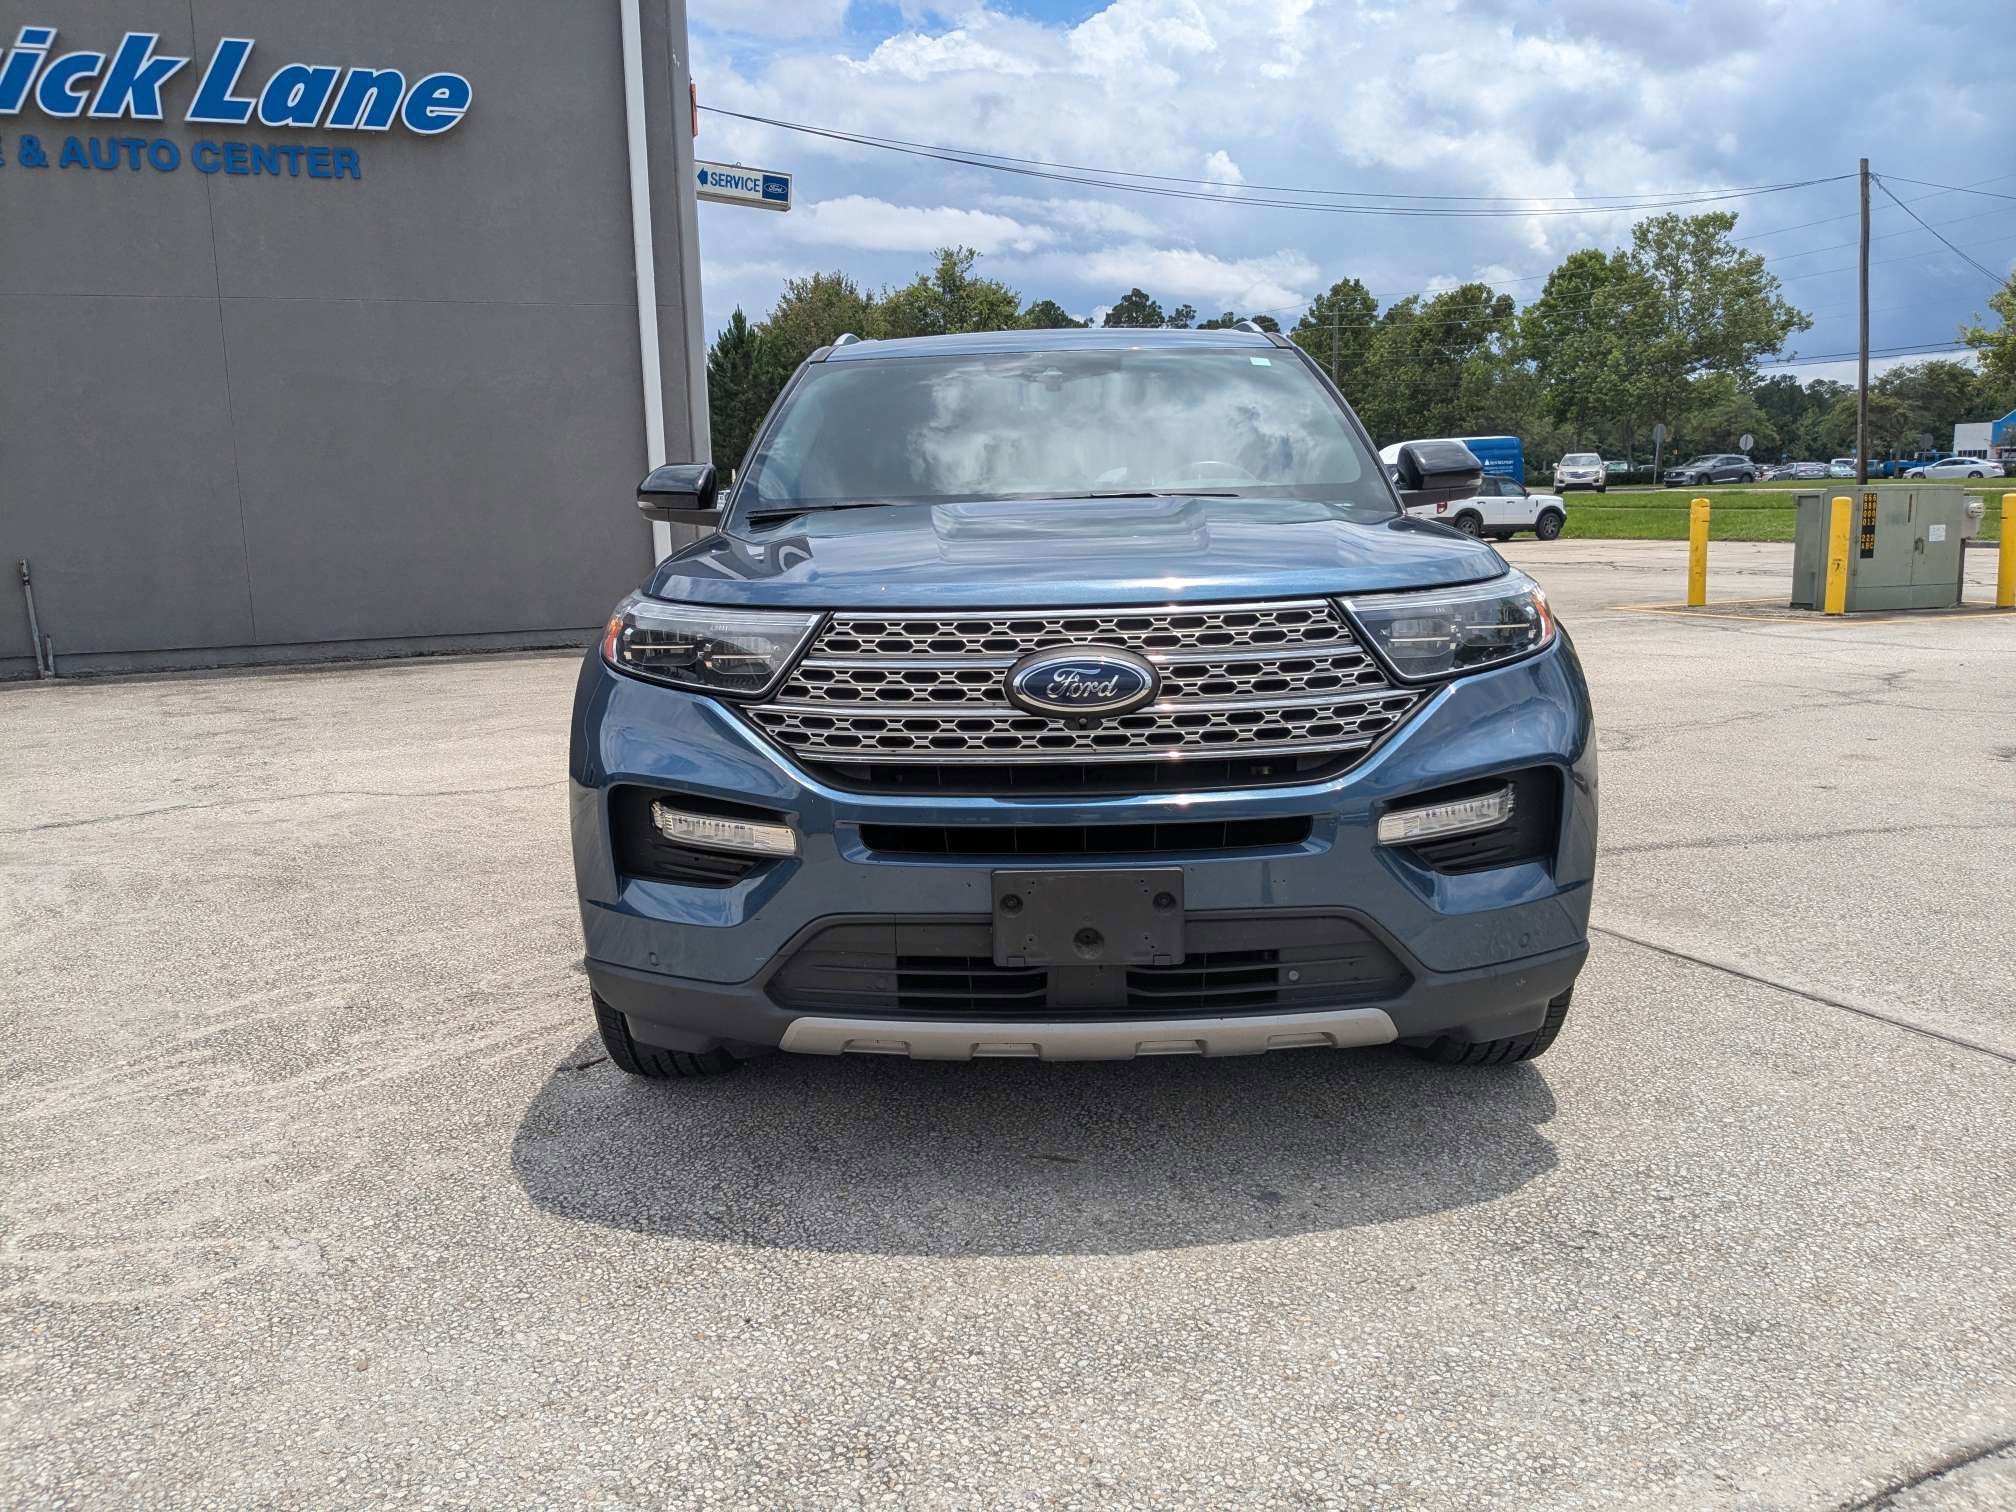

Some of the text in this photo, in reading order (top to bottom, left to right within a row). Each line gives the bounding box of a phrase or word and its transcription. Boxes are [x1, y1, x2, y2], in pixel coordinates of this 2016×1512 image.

[184, 37, 473, 135] Lane
[18, 134, 49, 168] &
[59, 136, 181, 172] AUTO
[191, 140, 361, 180] CENTER
[710, 172, 761, 193] SERVICE
[1046, 667, 1119, 699] Ford
